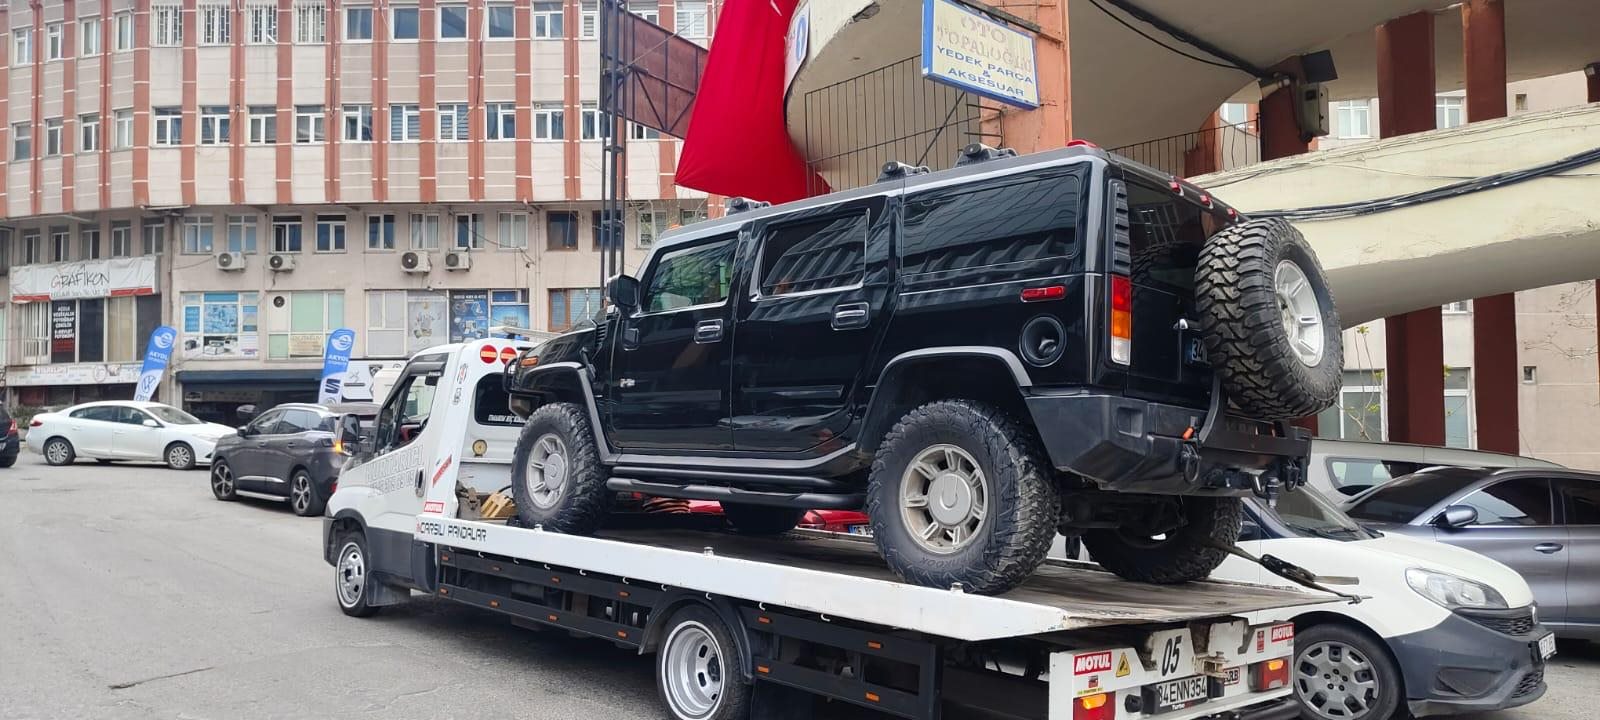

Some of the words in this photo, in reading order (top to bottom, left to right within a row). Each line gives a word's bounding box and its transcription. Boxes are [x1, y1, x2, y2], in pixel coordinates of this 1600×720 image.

[936, 45, 982, 67] YEDEK
[948, 67, 1024, 96] AKSESUAR
[983, 70, 991, 78] &
[1272, 625, 1294, 641] MOTUL
[1075, 653, 1111, 673] MOTUL
[1161, 635, 1182, 677] 05
